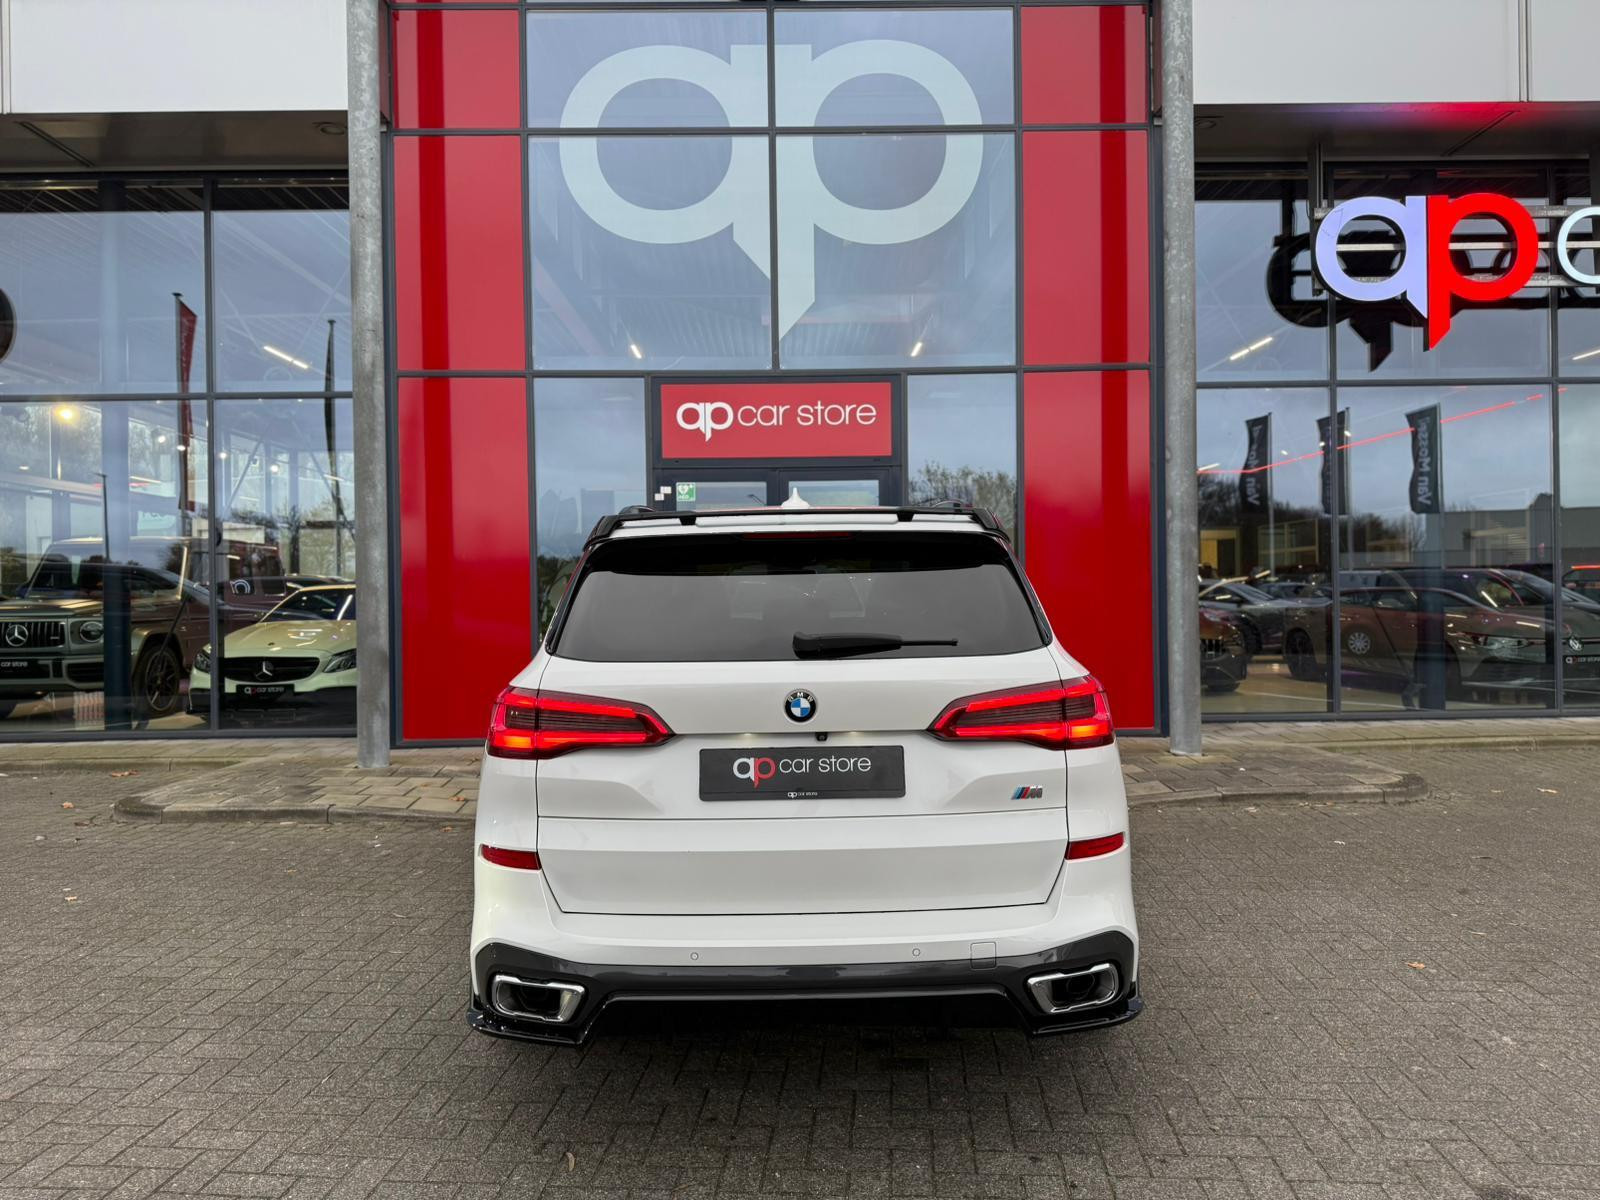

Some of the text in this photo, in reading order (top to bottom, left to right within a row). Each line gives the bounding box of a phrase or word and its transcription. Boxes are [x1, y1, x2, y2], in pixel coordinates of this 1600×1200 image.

[559, 39, 983, 341] ap
[1315, 192, 1539, 351] ap
[676, 400, 877, 442] ap car store
[732, 755, 872, 788] ap car store
